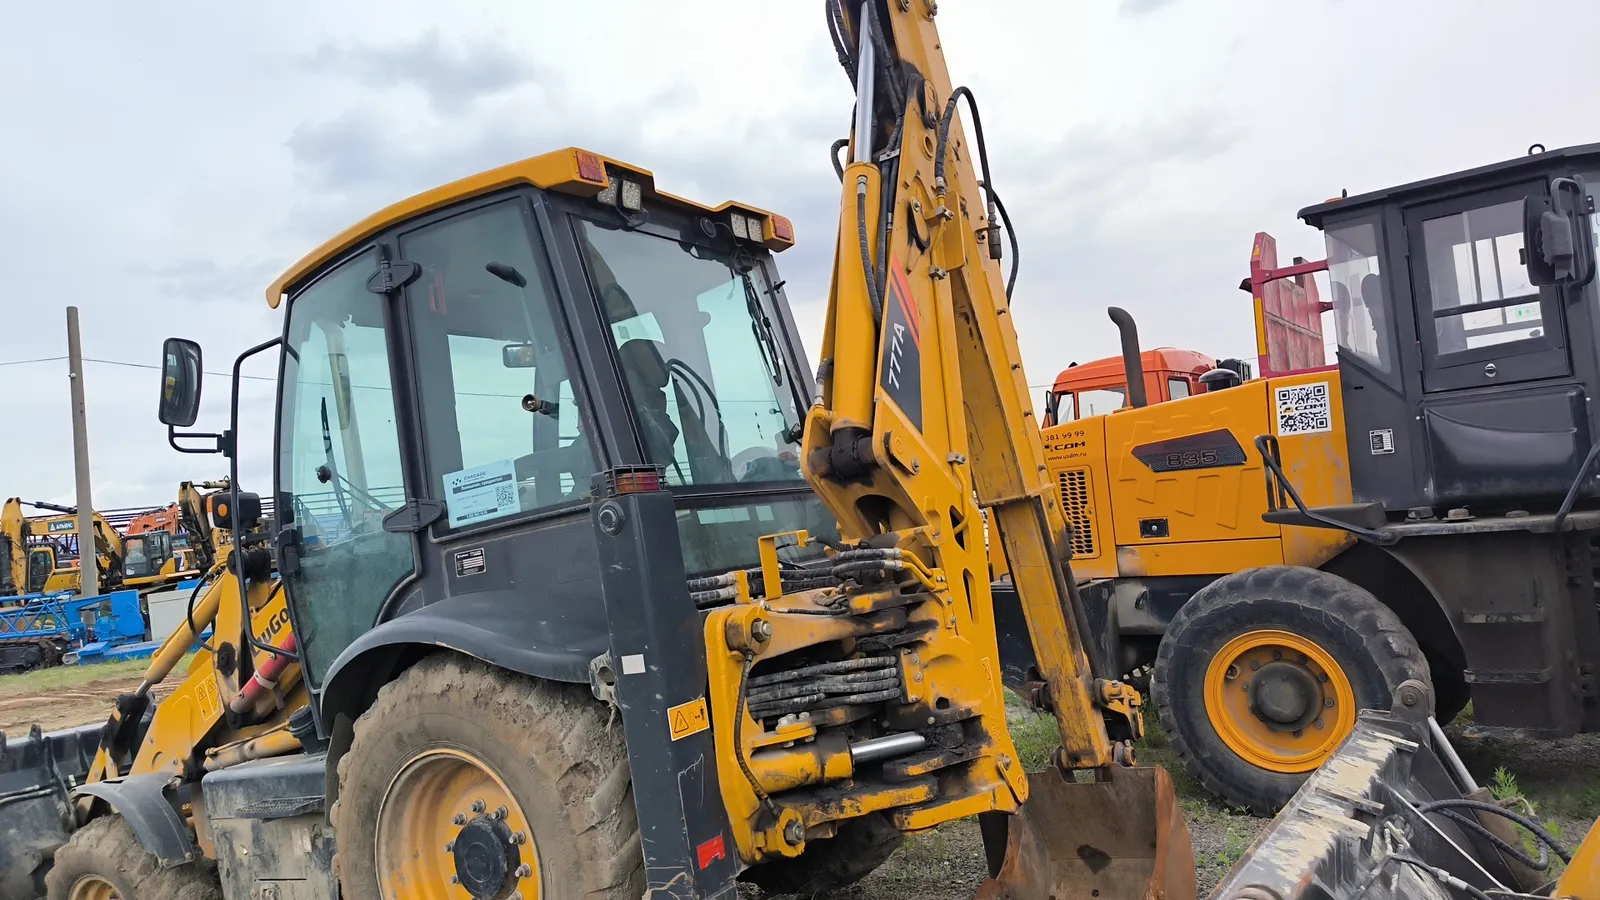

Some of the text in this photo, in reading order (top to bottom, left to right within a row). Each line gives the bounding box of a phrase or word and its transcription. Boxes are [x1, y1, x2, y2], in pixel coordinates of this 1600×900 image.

[888, 322, 905, 390] 777A
[1045, 430, 1085, 442] 381 99 99
[1166, 449, 1218, 467] 835
